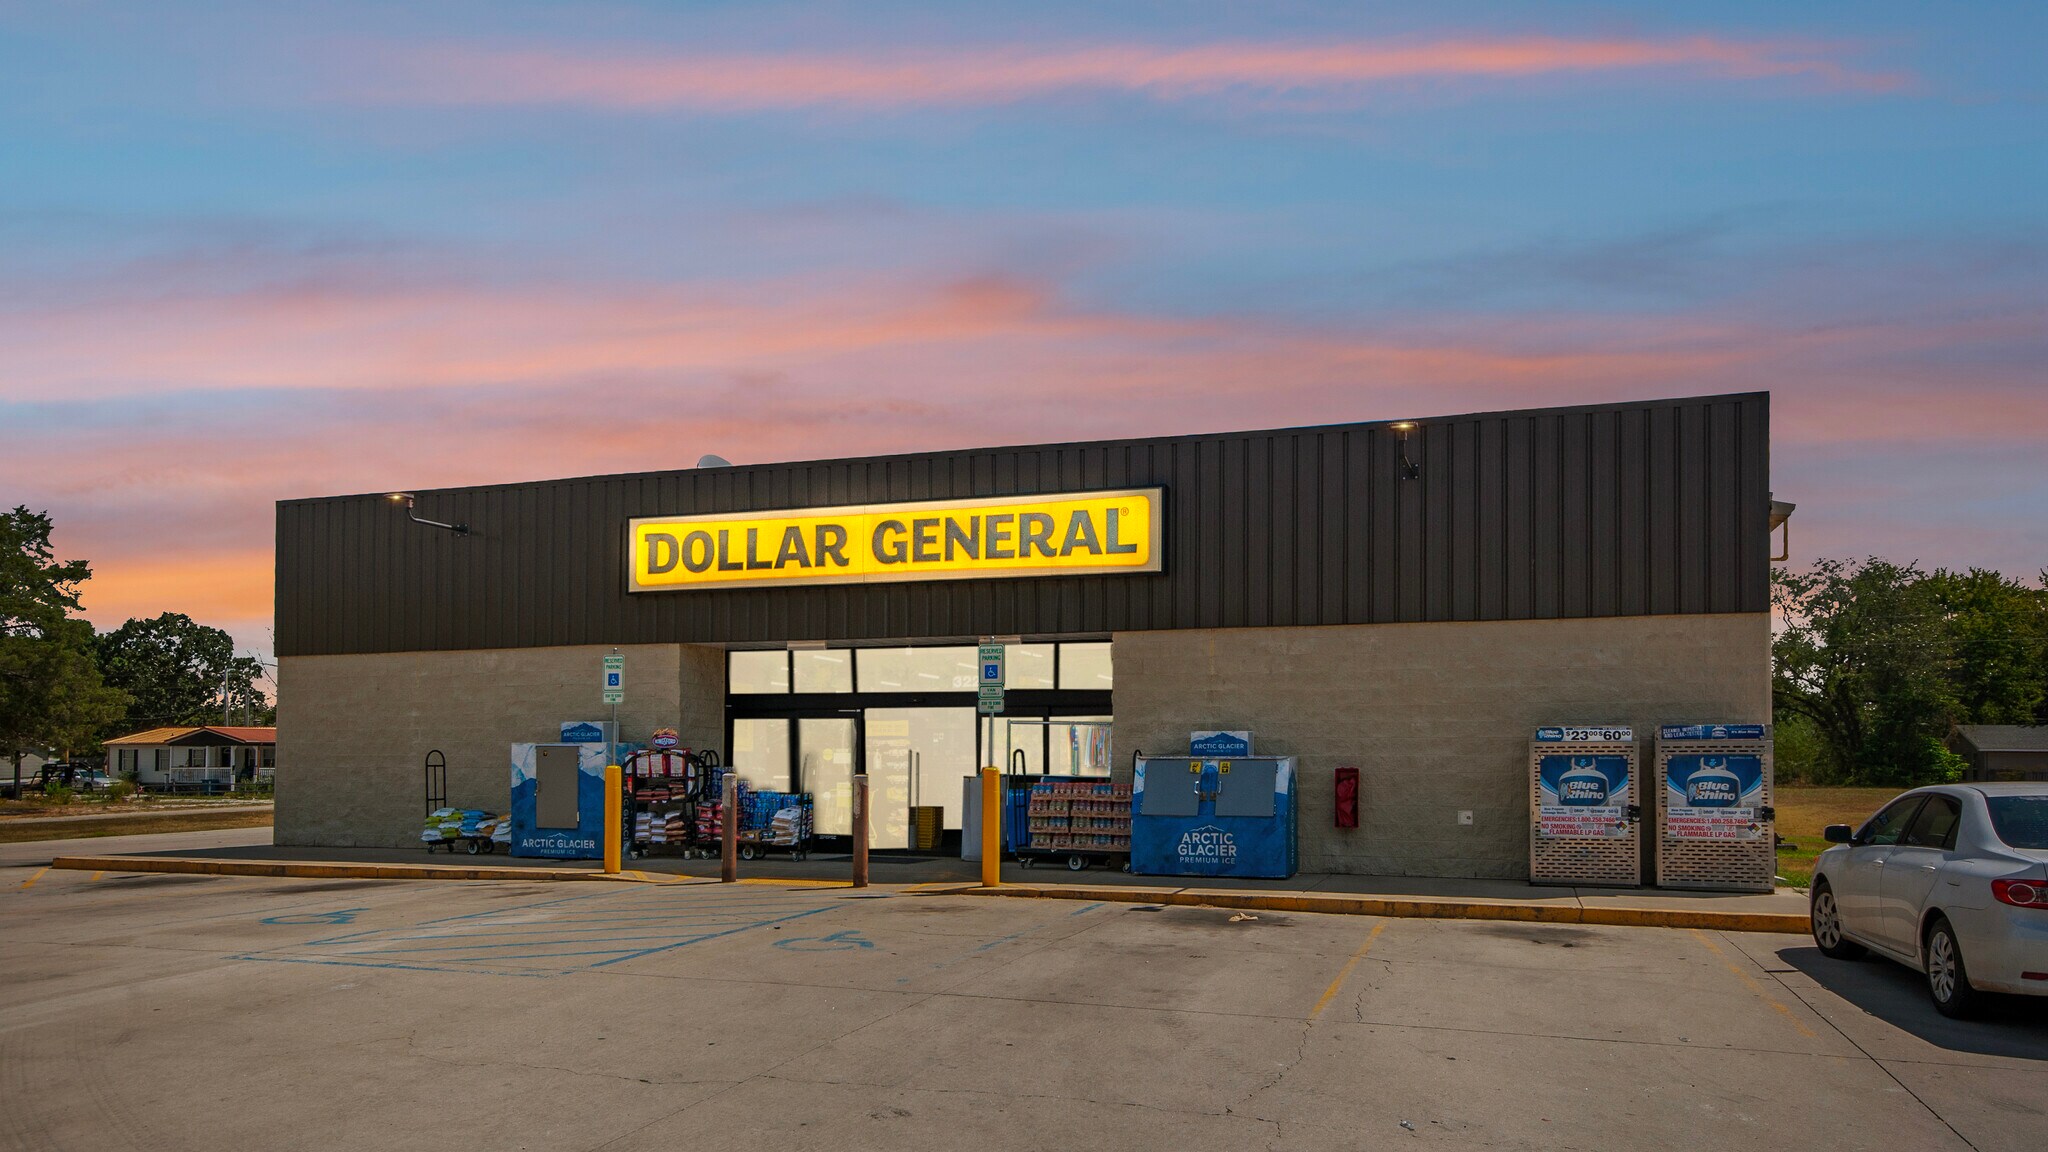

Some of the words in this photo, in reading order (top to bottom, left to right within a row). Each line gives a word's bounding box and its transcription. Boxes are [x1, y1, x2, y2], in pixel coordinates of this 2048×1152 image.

[644, 524, 850, 575] DOLLAR
[871, 507, 1138, 565] GENERAL
[1569, 781, 1598, 790] Blue
[1698, 782, 1730, 790] Blue
[1182, 832, 1234, 844] ARCTIC
[522, 839, 554, 848] ARCTIC
[557, 840, 595, 849] GLACIER
[1178, 844, 1237, 856] GLACIER
